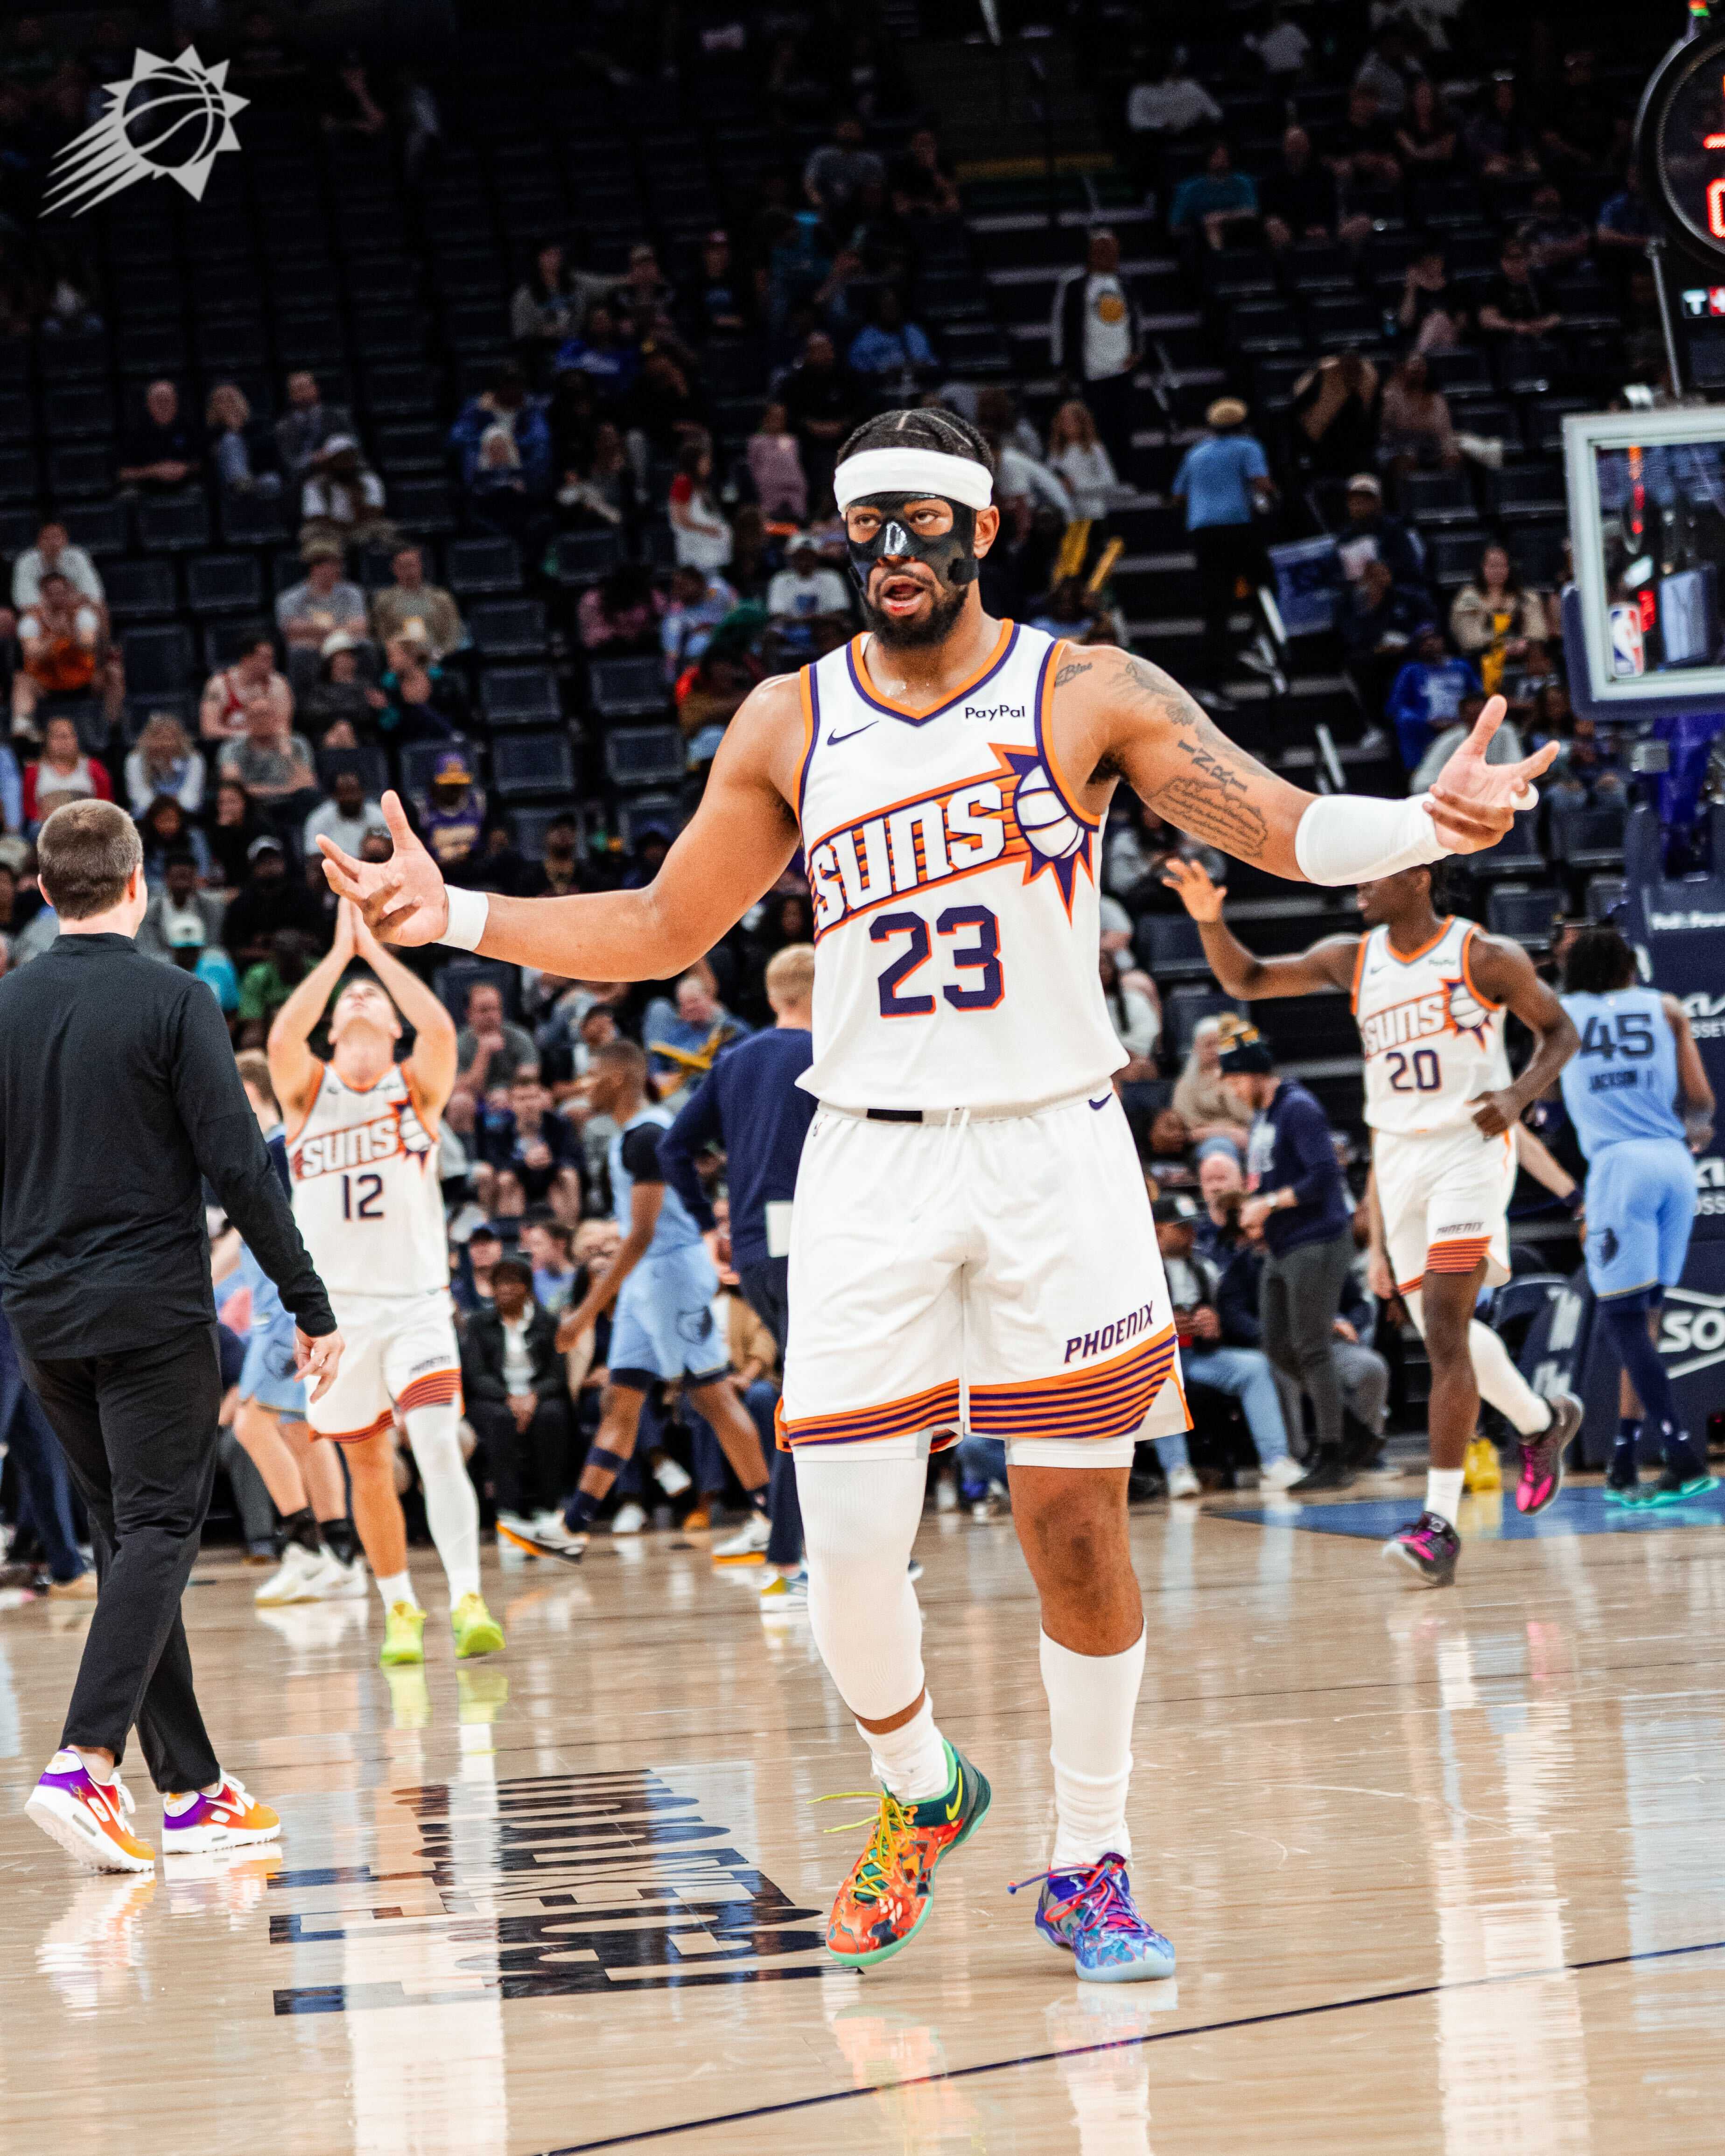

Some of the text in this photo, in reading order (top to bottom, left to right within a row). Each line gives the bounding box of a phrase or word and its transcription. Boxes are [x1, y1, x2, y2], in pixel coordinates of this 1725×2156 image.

[964, 704, 1026, 721] PayPal
[810, 781, 1004, 932] SUNS
[869, 904, 1005, 1019] 23
[1364, 994, 1445, 1053] SUNS
[1580, 1013, 1655, 1062] 45
[1385, 1049, 1442, 1093] 20
[302, 1116, 398, 1177] SUNS
[341, 1173, 385, 1222] 12
[1435, 1221, 1485, 1237] PHOENIX
[1064, 1300, 1155, 1365] PHOENIX
